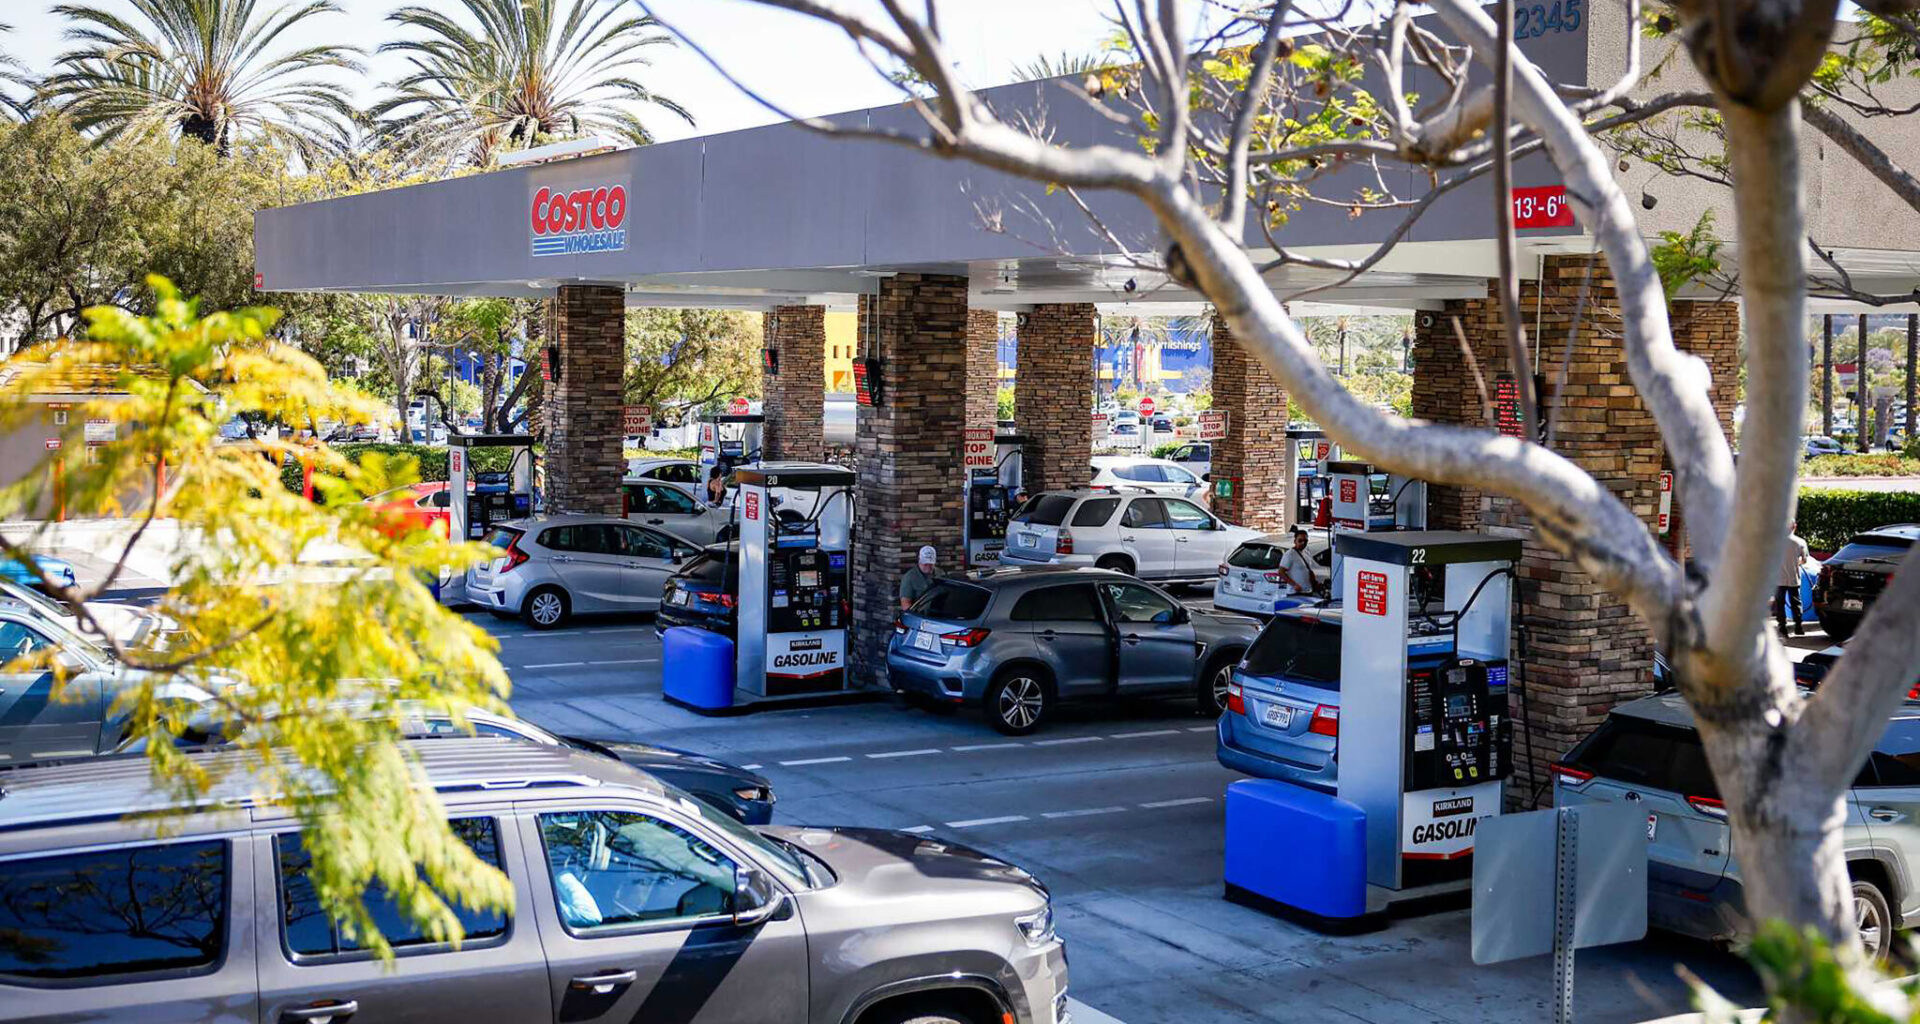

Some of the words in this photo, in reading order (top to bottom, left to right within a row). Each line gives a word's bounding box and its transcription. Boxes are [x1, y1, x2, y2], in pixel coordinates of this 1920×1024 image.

[1514, 0, 1580, 39] 2345
[531, 185, 627, 235] COSTCO
[564, 231, 626, 254] WHOLESALE
[730, 403, 749, 413] STOP
[966, 431, 991, 440] MOKING
[1200, 430, 1225, 438] ENGINE
[964, 443, 987, 453] TOP
[965, 456, 993, 465] GINE
[767, 475, 779, 486] 20
[975, 552, 999, 561] GASOL
[1411, 548, 1427, 564] 22
[791, 640, 821, 648] KIRKLAND
[774, 652, 838, 668] GASOLINE
[1434, 799, 1472, 811] KIRKLAND
[1412, 816, 1478, 845] GASOLIN
